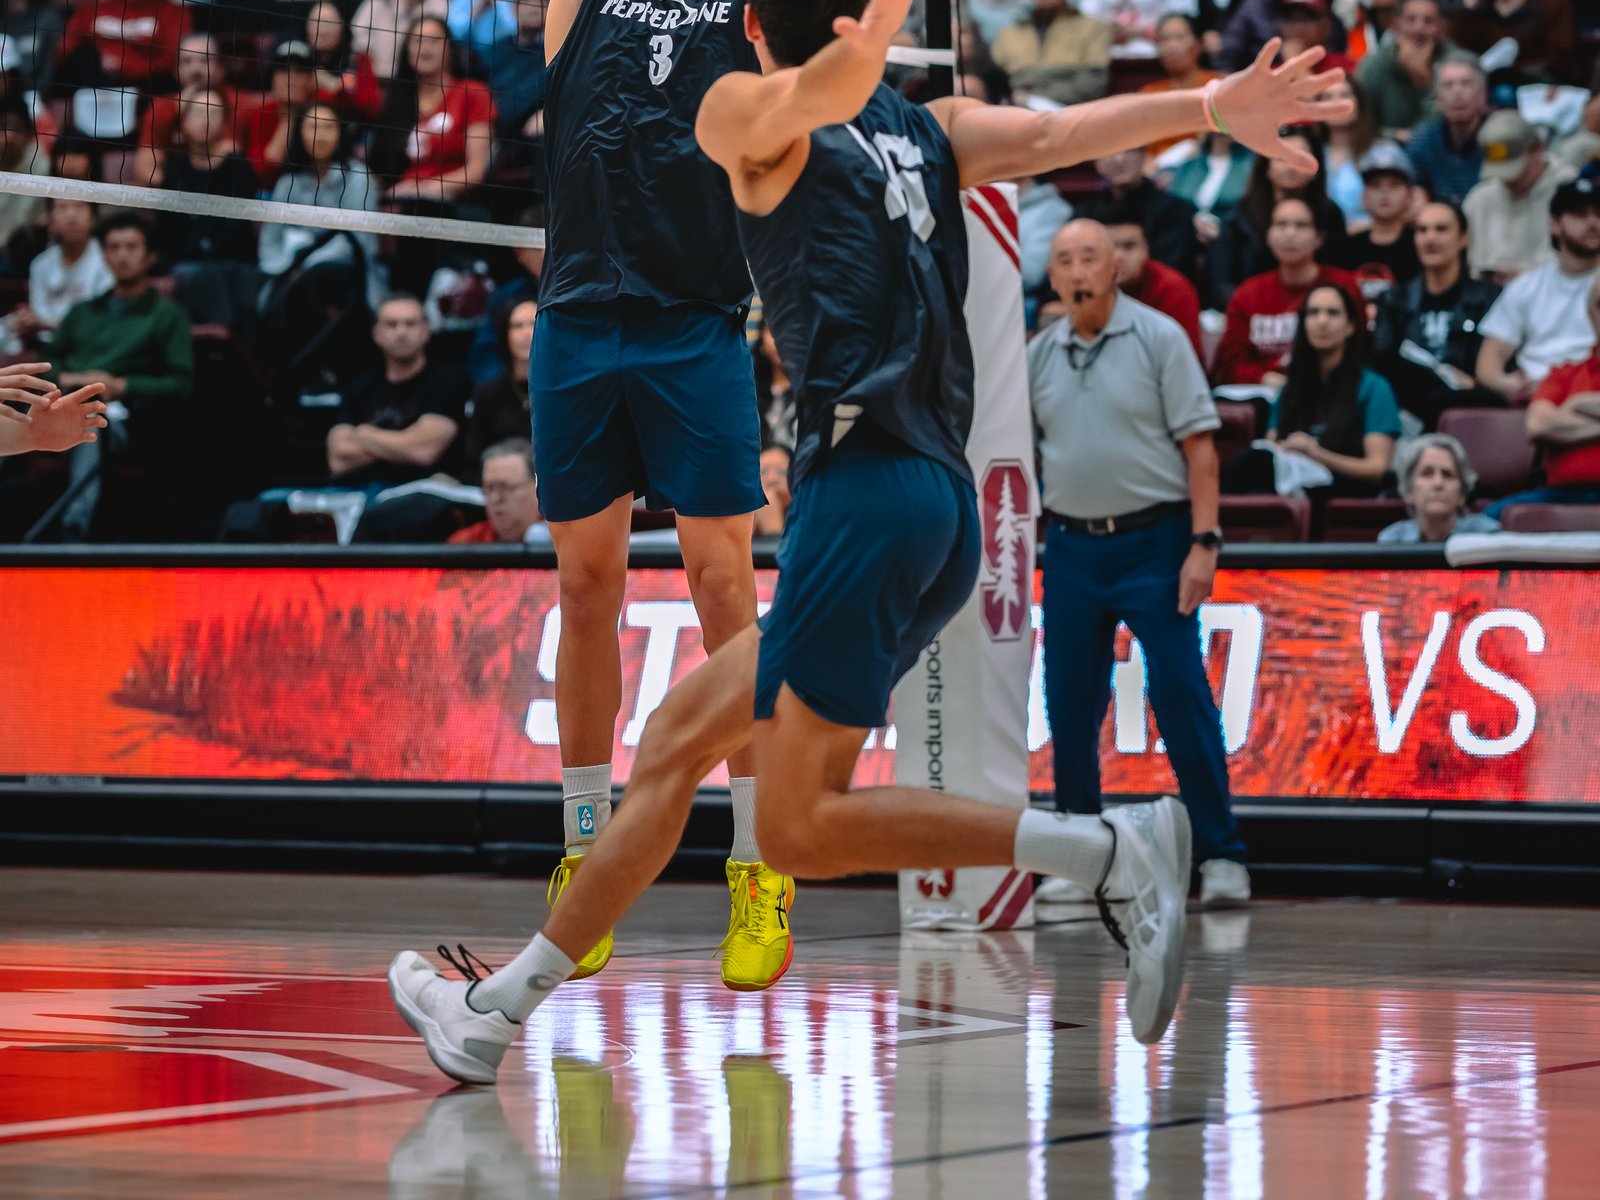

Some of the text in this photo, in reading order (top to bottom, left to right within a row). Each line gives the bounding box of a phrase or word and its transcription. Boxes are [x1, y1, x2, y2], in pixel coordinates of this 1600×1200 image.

[648, 34, 673, 85] 3
[924, 640, 945, 791] ports import
[1361, 610, 1547, 757] VS
